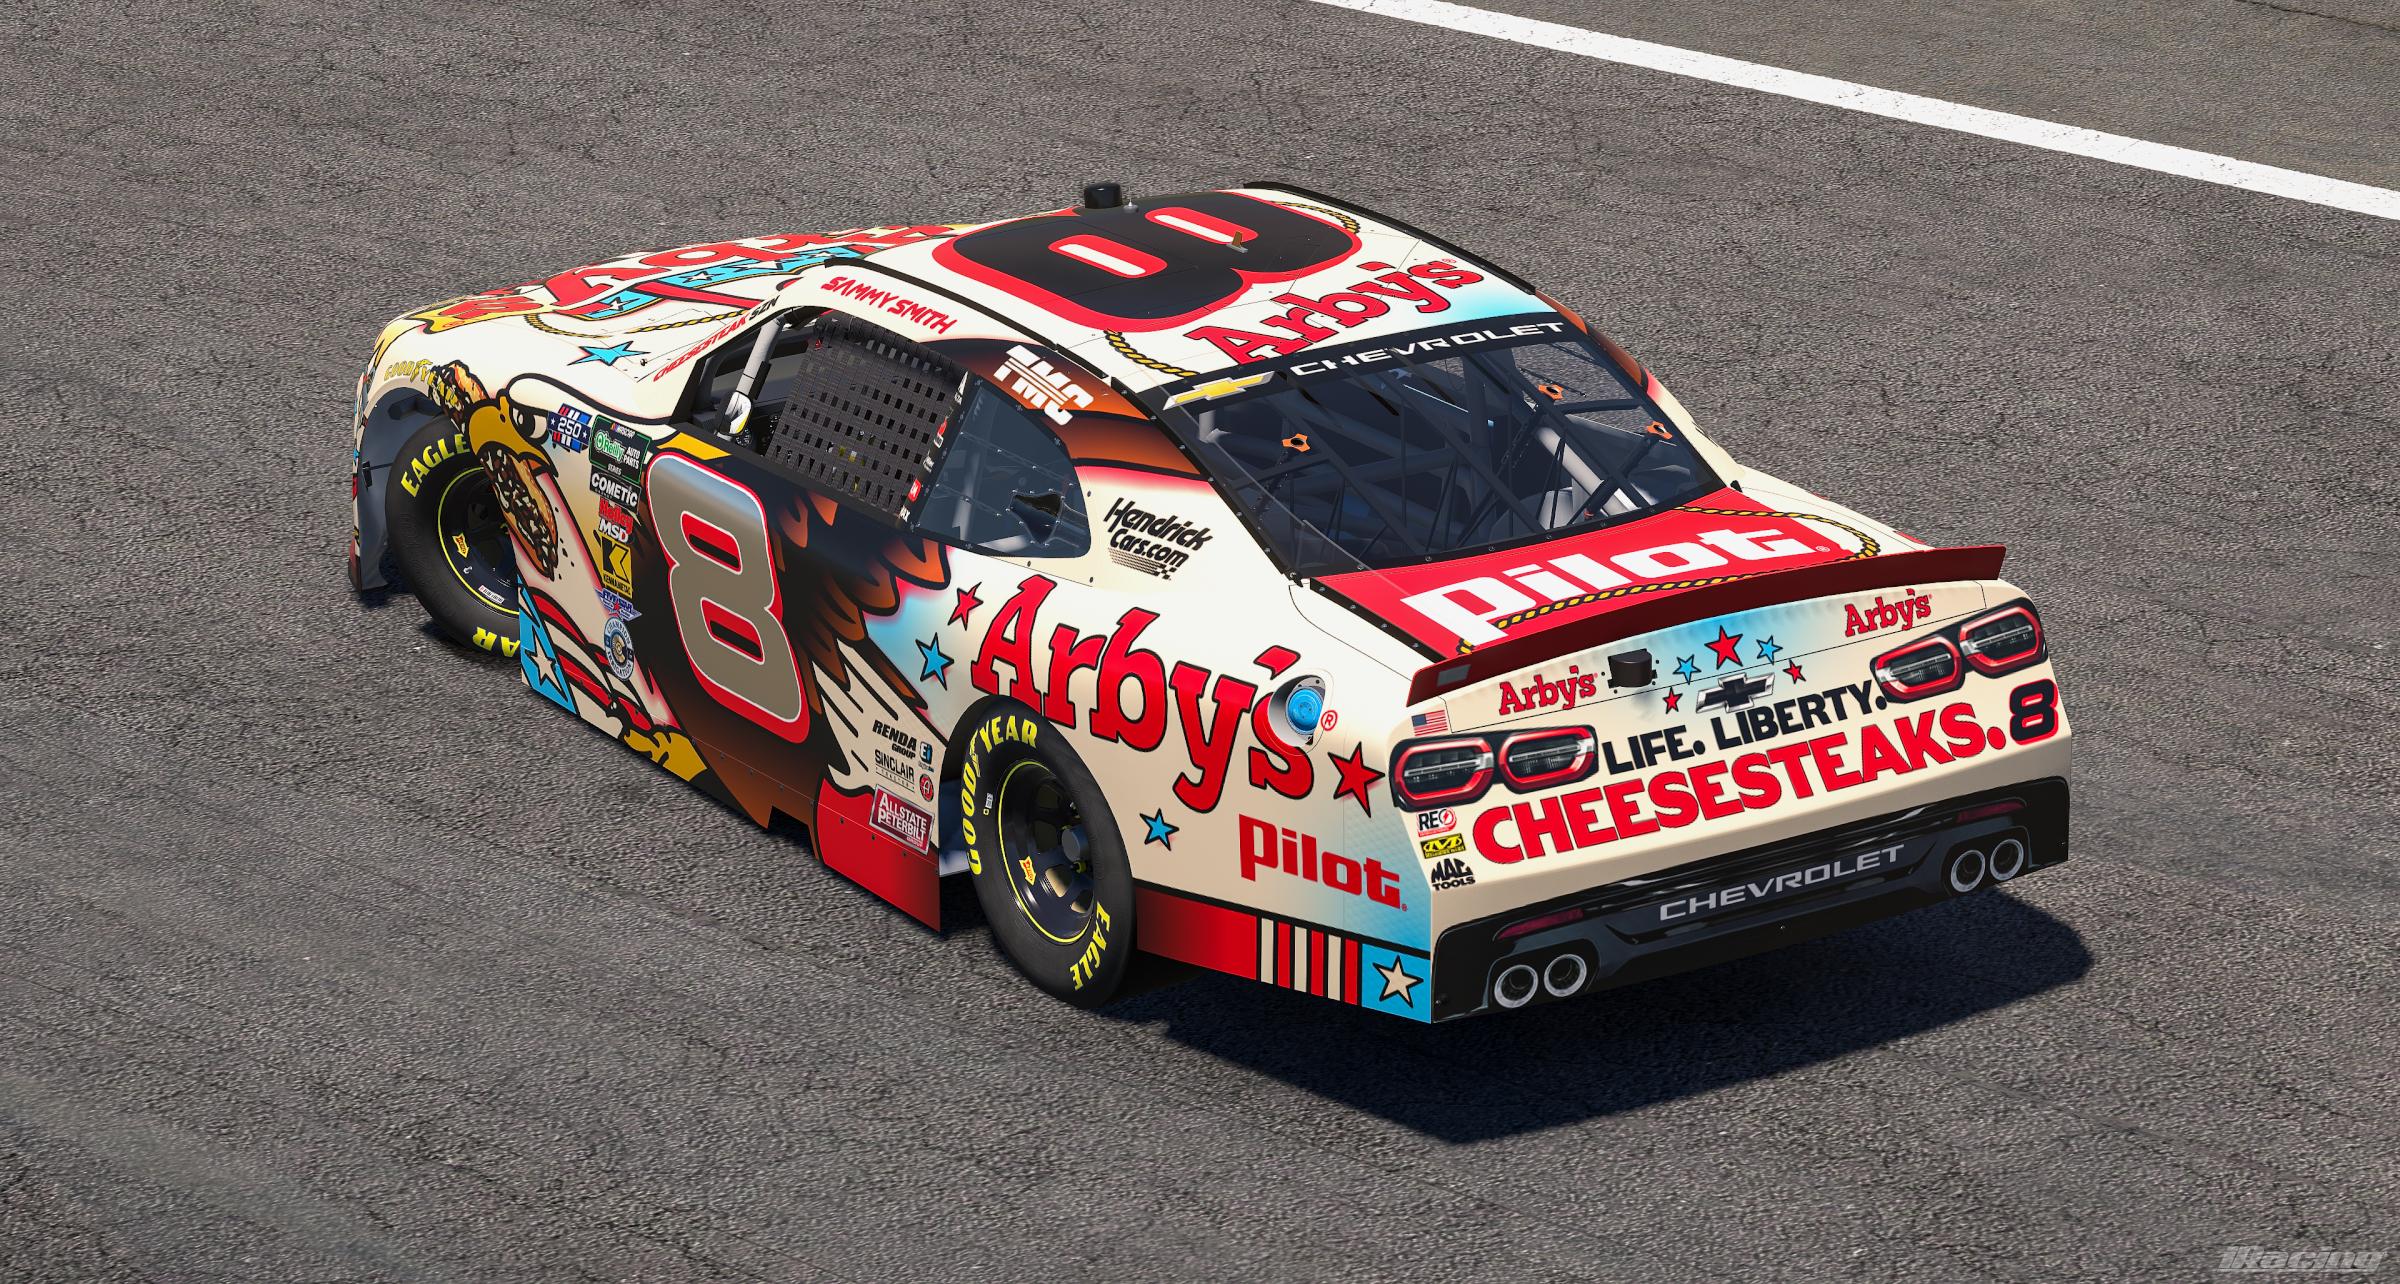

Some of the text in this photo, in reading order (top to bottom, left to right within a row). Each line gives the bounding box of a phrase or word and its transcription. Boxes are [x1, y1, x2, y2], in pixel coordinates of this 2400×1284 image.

[931, 188, 1362, 334] 8
[749, 294, 781, 321] SZN
[821, 276, 958, 335] SAMMY SMITH
[1184, 260, 1484, 366] Arby's
[1290, 320, 1566, 377] CHEVROLET
[993, 344, 1094, 426] TMC
[557, 417, 582, 439] 250
[625, 446, 641, 460] AUTO
[401, 434, 470, 498] EAGLE
[623, 455, 640, 470] PARTS
[591, 473, 638, 508] COMETIC
[599, 518, 629, 543] MSD
[1103, 497, 1213, 551] Hendrick
[1109, 527, 1190, 568] Cars.com
[646, 451, 811, 744] 8
[1844, 587, 1931, 637] Arby's
[971, 573, 1313, 814] Arby's
[1499, 664, 1597, 715] Arby's
[2009, 679, 2059, 745] 8
[872, 719, 917, 752] RENDA
[892, 743, 916, 760] GROUP
[1602, 680, 1888, 774] LIFE. LIBERTY.
[874, 749, 915, 782] SINCLAIR
[1472, 703, 2006, 864] CHEESESTEAKS.
[879, 792, 927, 831] ALLSTATE
[961, 715, 1038, 875] GOODYEAR
[878, 807, 927, 842] PETERBILT
[1431, 858, 1474, 883] MAC
[1433, 876, 1476, 891] TOOLS
[1659, 843, 1905, 922] CHEVROLET
[1069, 901, 1110, 991] EAGLE
